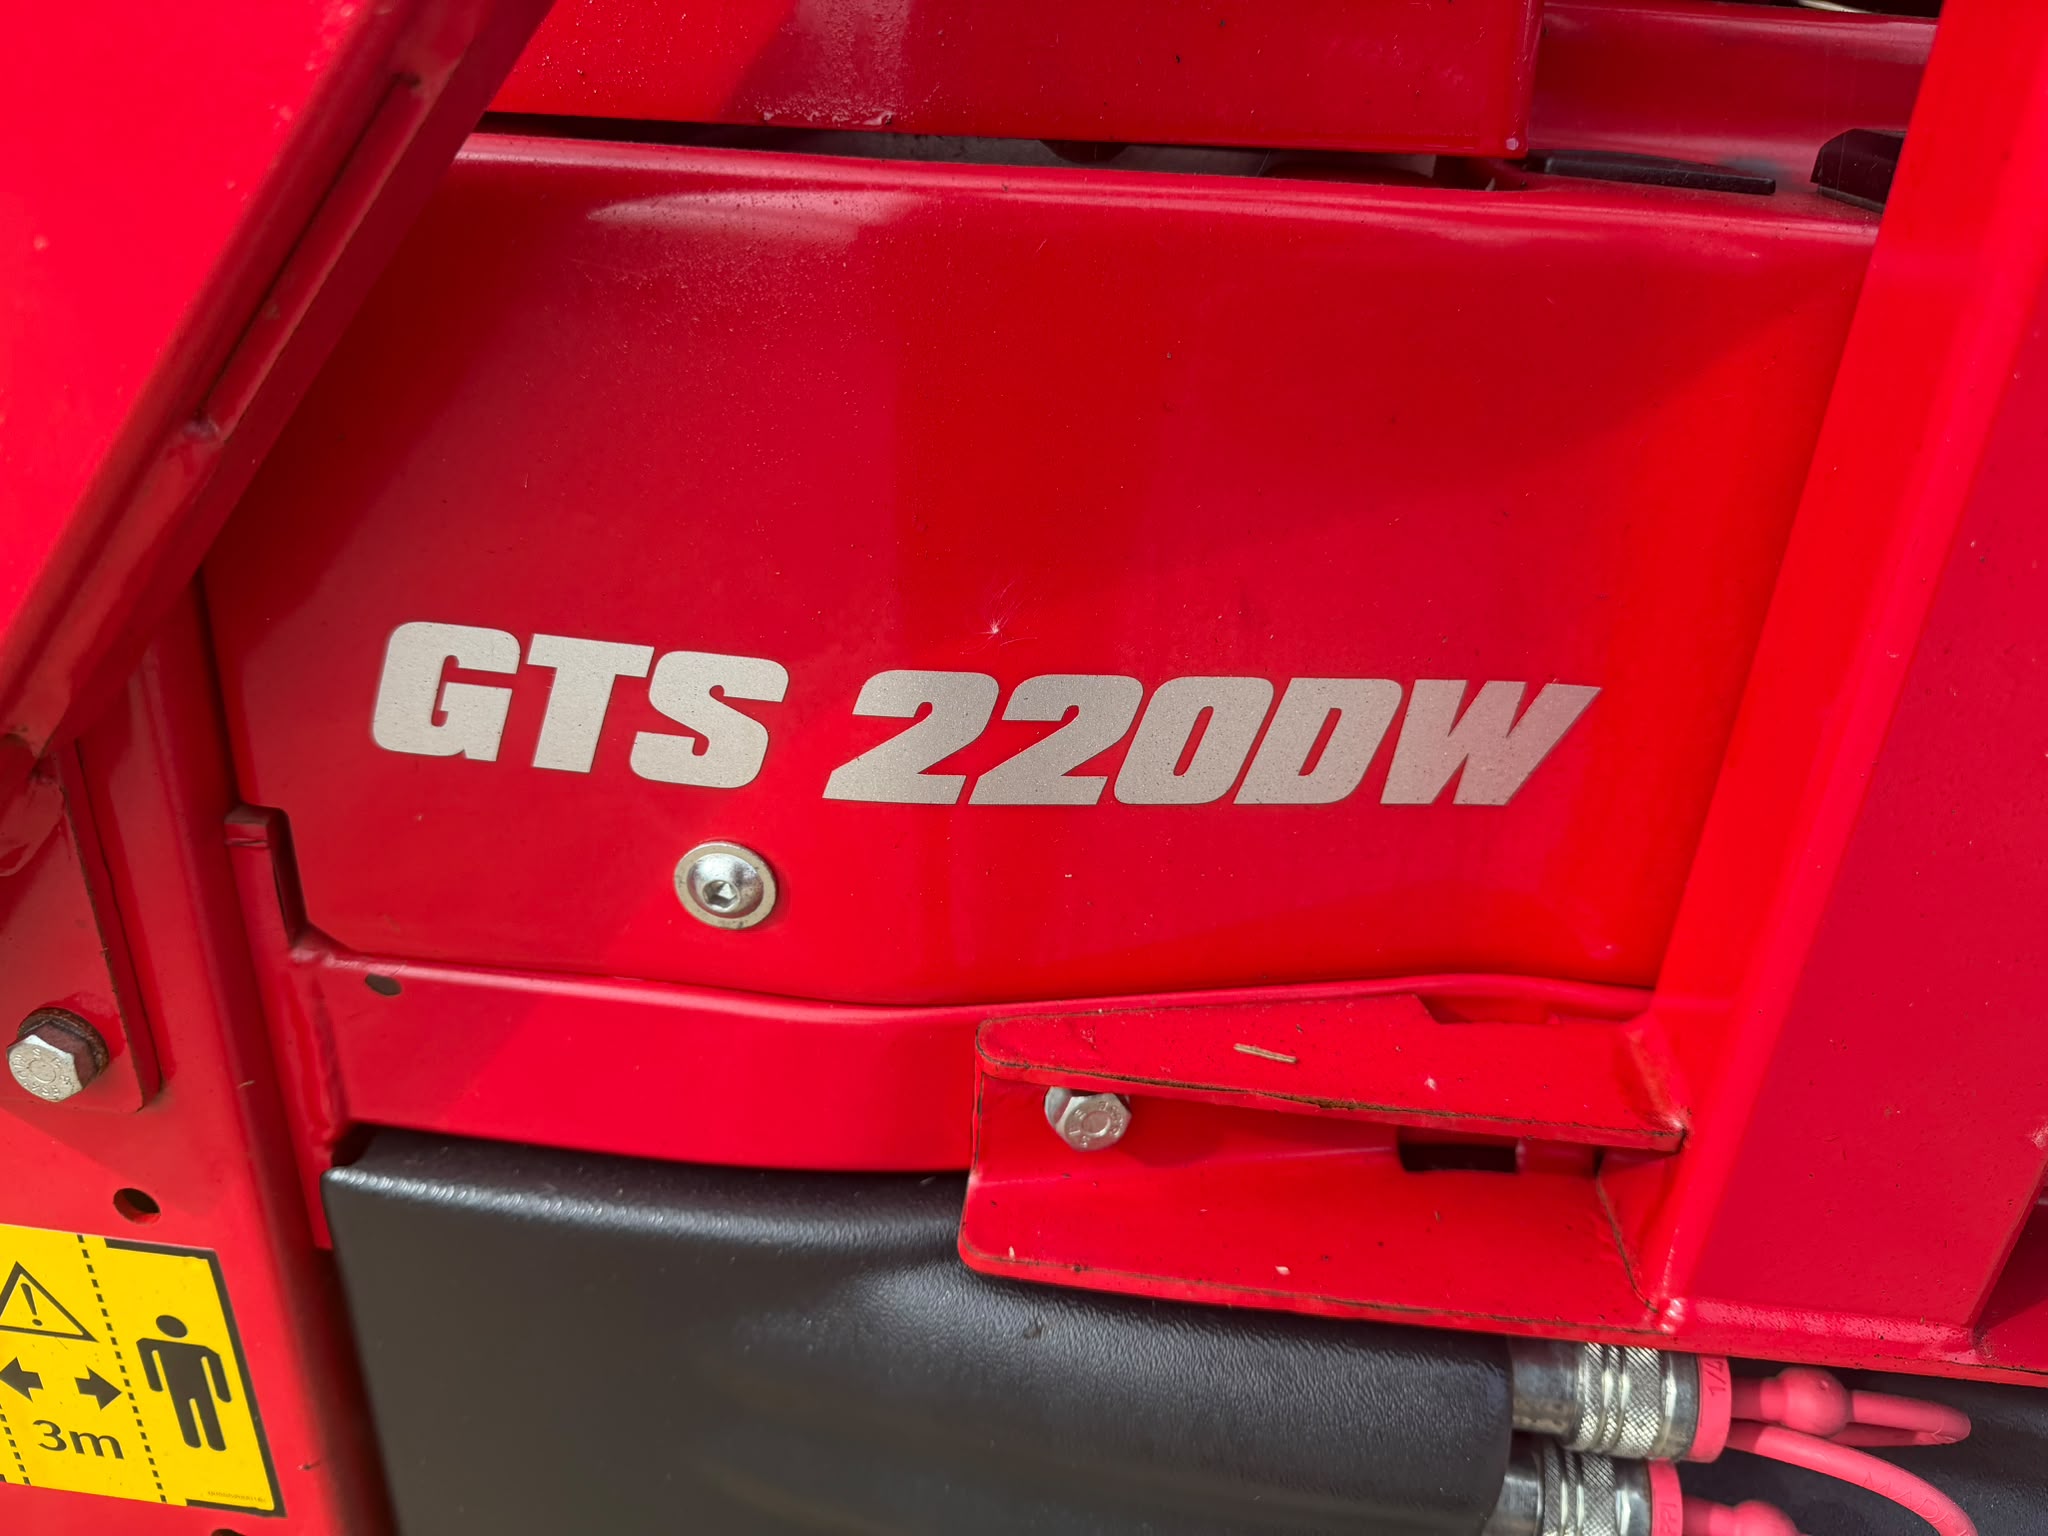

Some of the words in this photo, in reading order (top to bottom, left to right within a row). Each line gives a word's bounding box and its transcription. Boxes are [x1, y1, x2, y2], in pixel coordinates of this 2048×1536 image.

[371, 621, 789, 789] GTS
[822, 669, 1601, 806] 220DW
[32, 1419, 125, 1460] 3m
